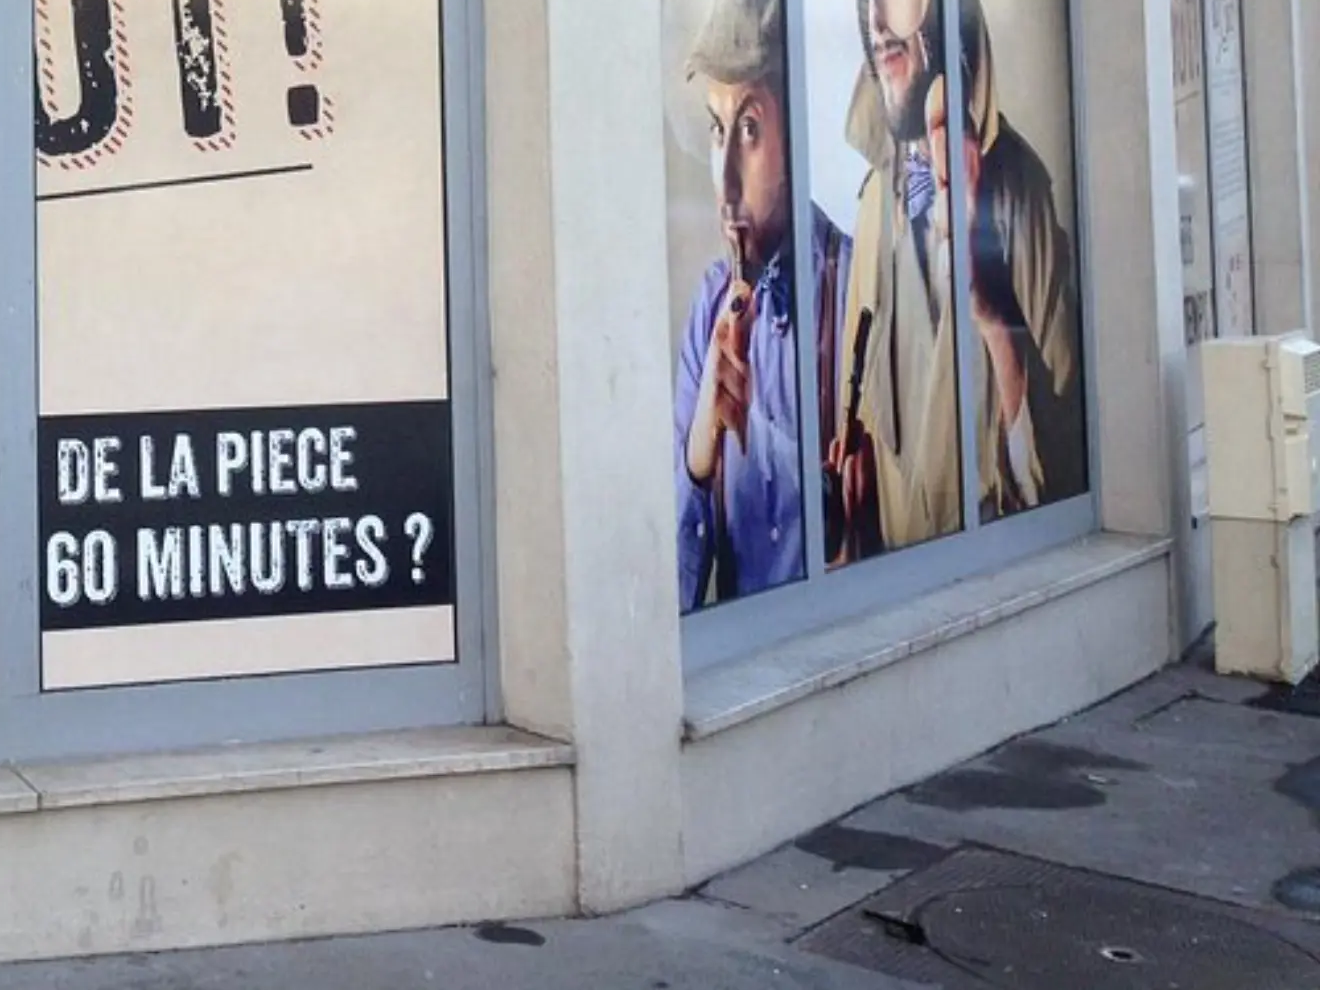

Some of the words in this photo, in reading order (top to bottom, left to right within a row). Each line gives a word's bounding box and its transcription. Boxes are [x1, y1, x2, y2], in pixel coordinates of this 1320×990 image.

[57, 437, 122, 505] DE
[140, 433, 200, 501] LA
[217, 426, 359, 496] PIECE
[46, 529, 118, 607] 60
[137, 515, 390, 601] MINUTES
[404, 511, 435, 585] ?
